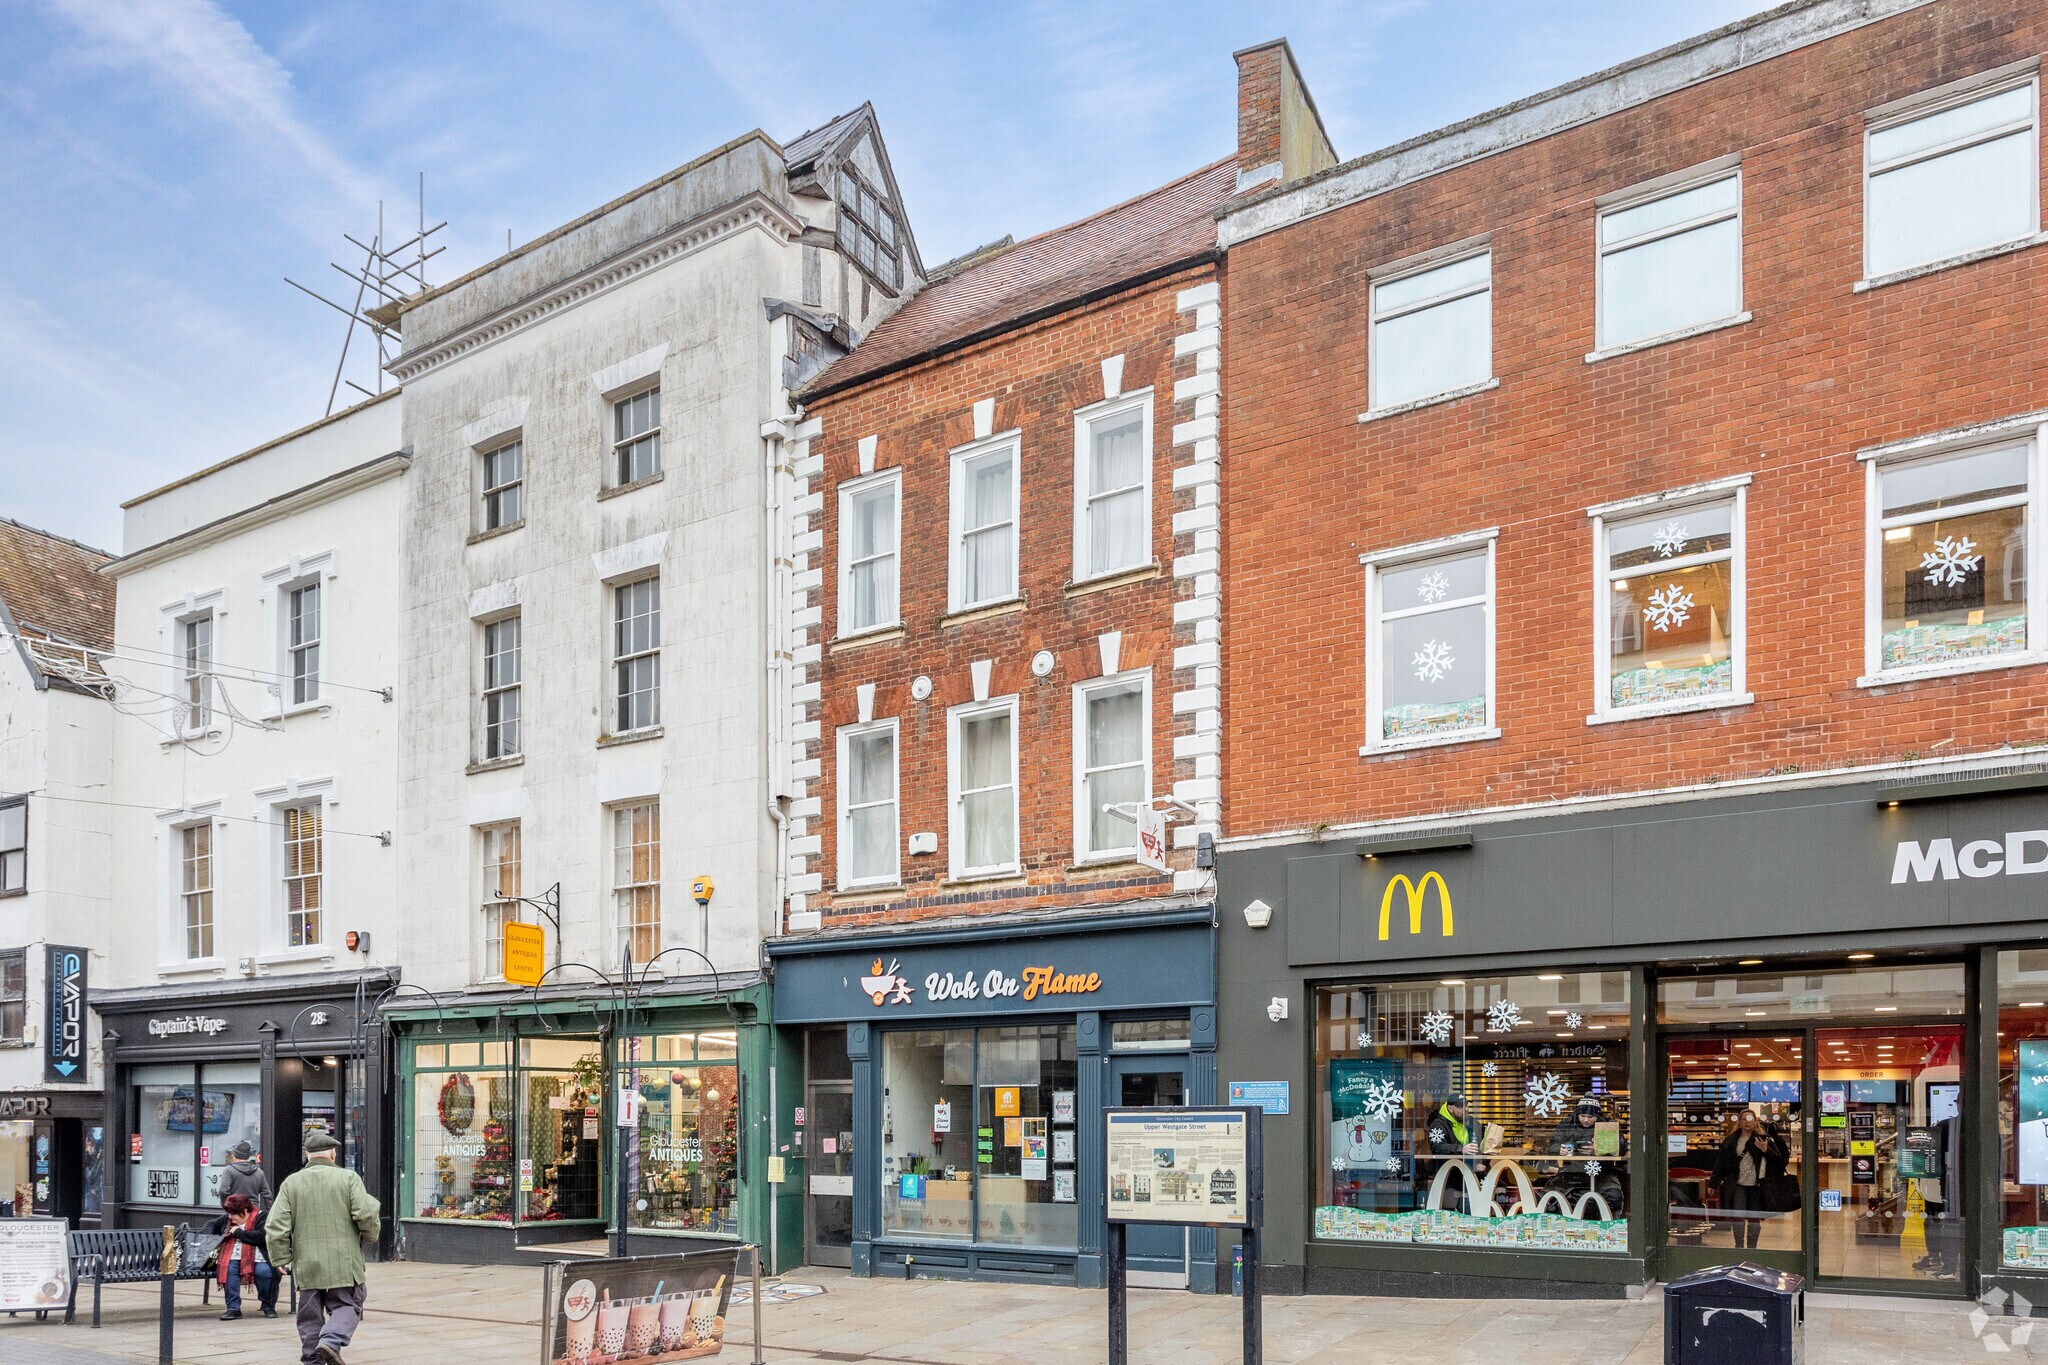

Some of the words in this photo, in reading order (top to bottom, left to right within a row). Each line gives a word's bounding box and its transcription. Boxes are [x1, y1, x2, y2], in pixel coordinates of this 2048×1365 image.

[508, 935, 540, 945] GLOUCESTER
[512, 949, 538, 958] ANTIQUES
[513, 964, 534, 972] CENTRE
[925, 971, 979, 1001] Wok
[983, 969, 1019, 999] On
[1022, 966, 1101, 1001] Flame
[310, 1011, 324, 1026] 28
[148, 1016, 194, 1039] Captain's
[196, 1016, 226, 1036] Vape
[1347, 1076, 1369, 1084] Fancy
[650, 1134, 703, 1148] Gloucester
[443, 1144, 487, 1157] ANTIQUES
[648, 1147, 704, 1162] ANTIQUES
[148, 1170, 179, 1184] ULTIMATE
[1821, 1193, 1840, 1201] CITY
[1821, 1199, 1840, 1207] SAFE
